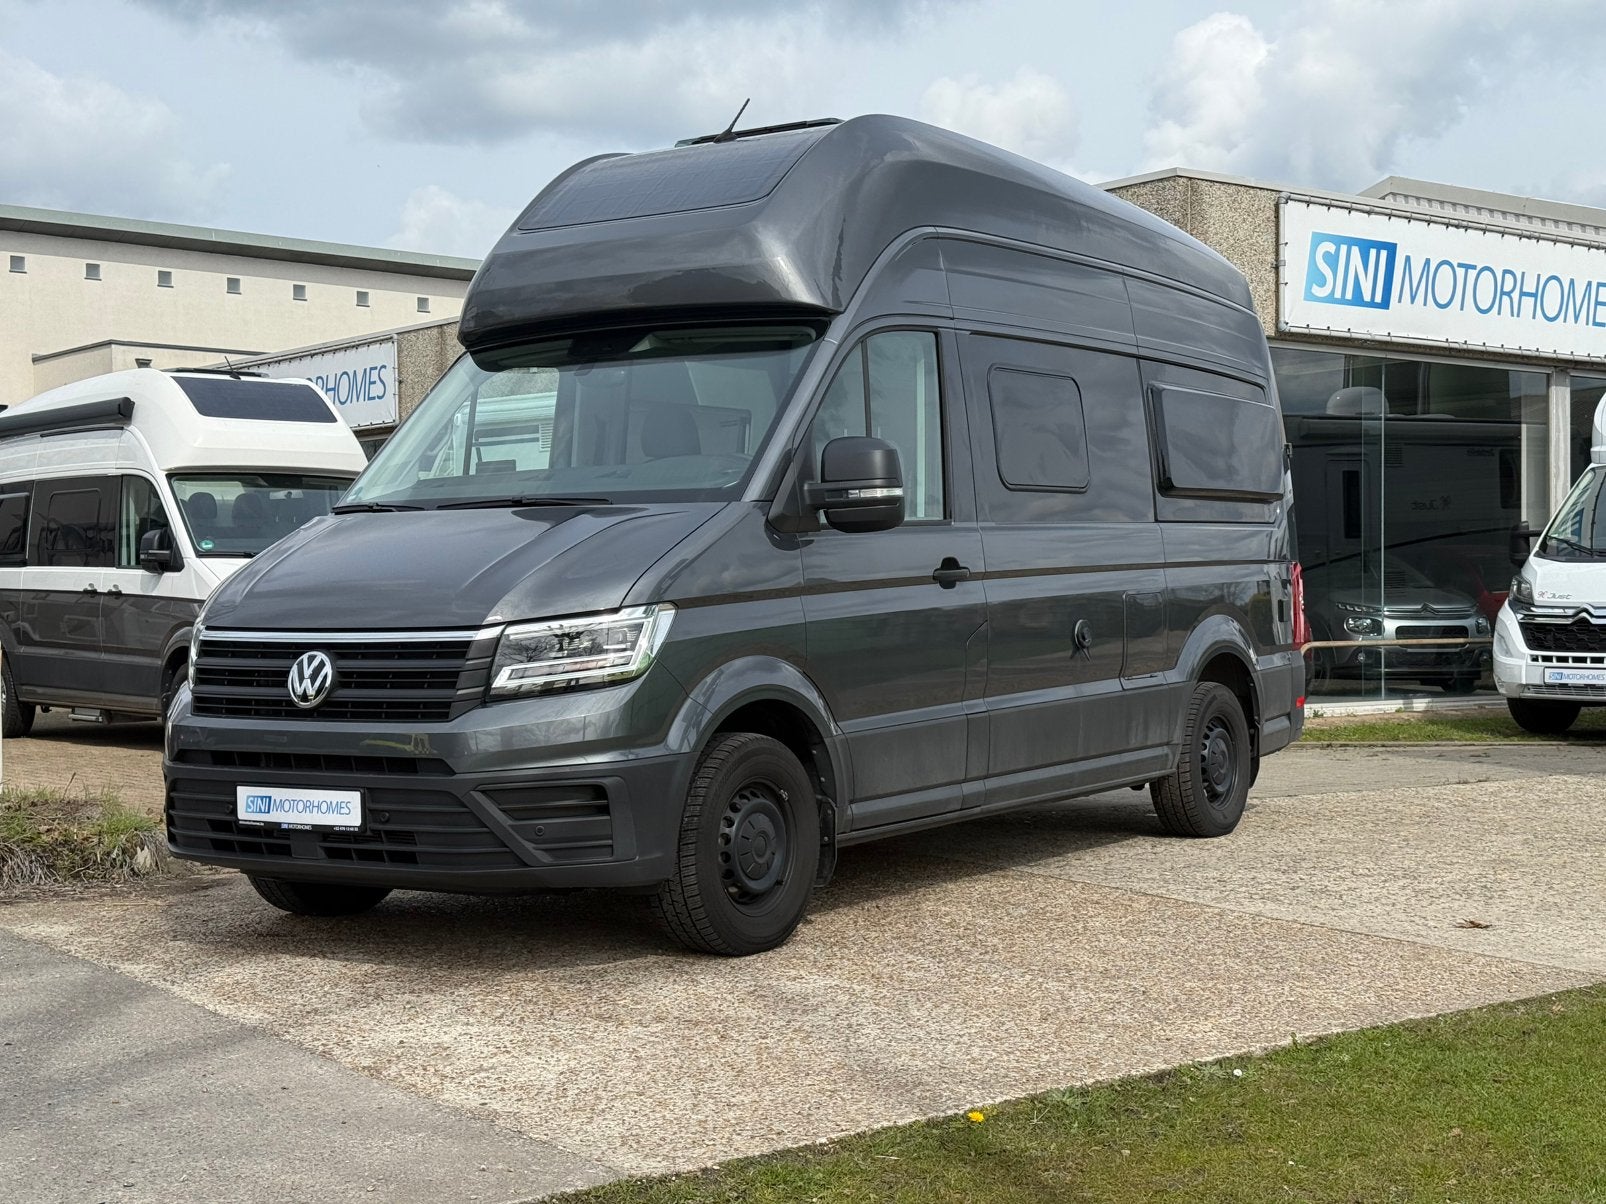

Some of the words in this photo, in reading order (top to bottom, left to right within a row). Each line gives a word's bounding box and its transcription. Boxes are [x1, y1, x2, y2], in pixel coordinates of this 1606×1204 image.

[1311, 241, 1387, 304] SINI
[290, 652, 331, 704] VW
[1563, 672, 1605, 681] MOTORHOMES
[246, 796, 270, 813] SINI
[272, 798, 352, 816] MOTORHOMES
